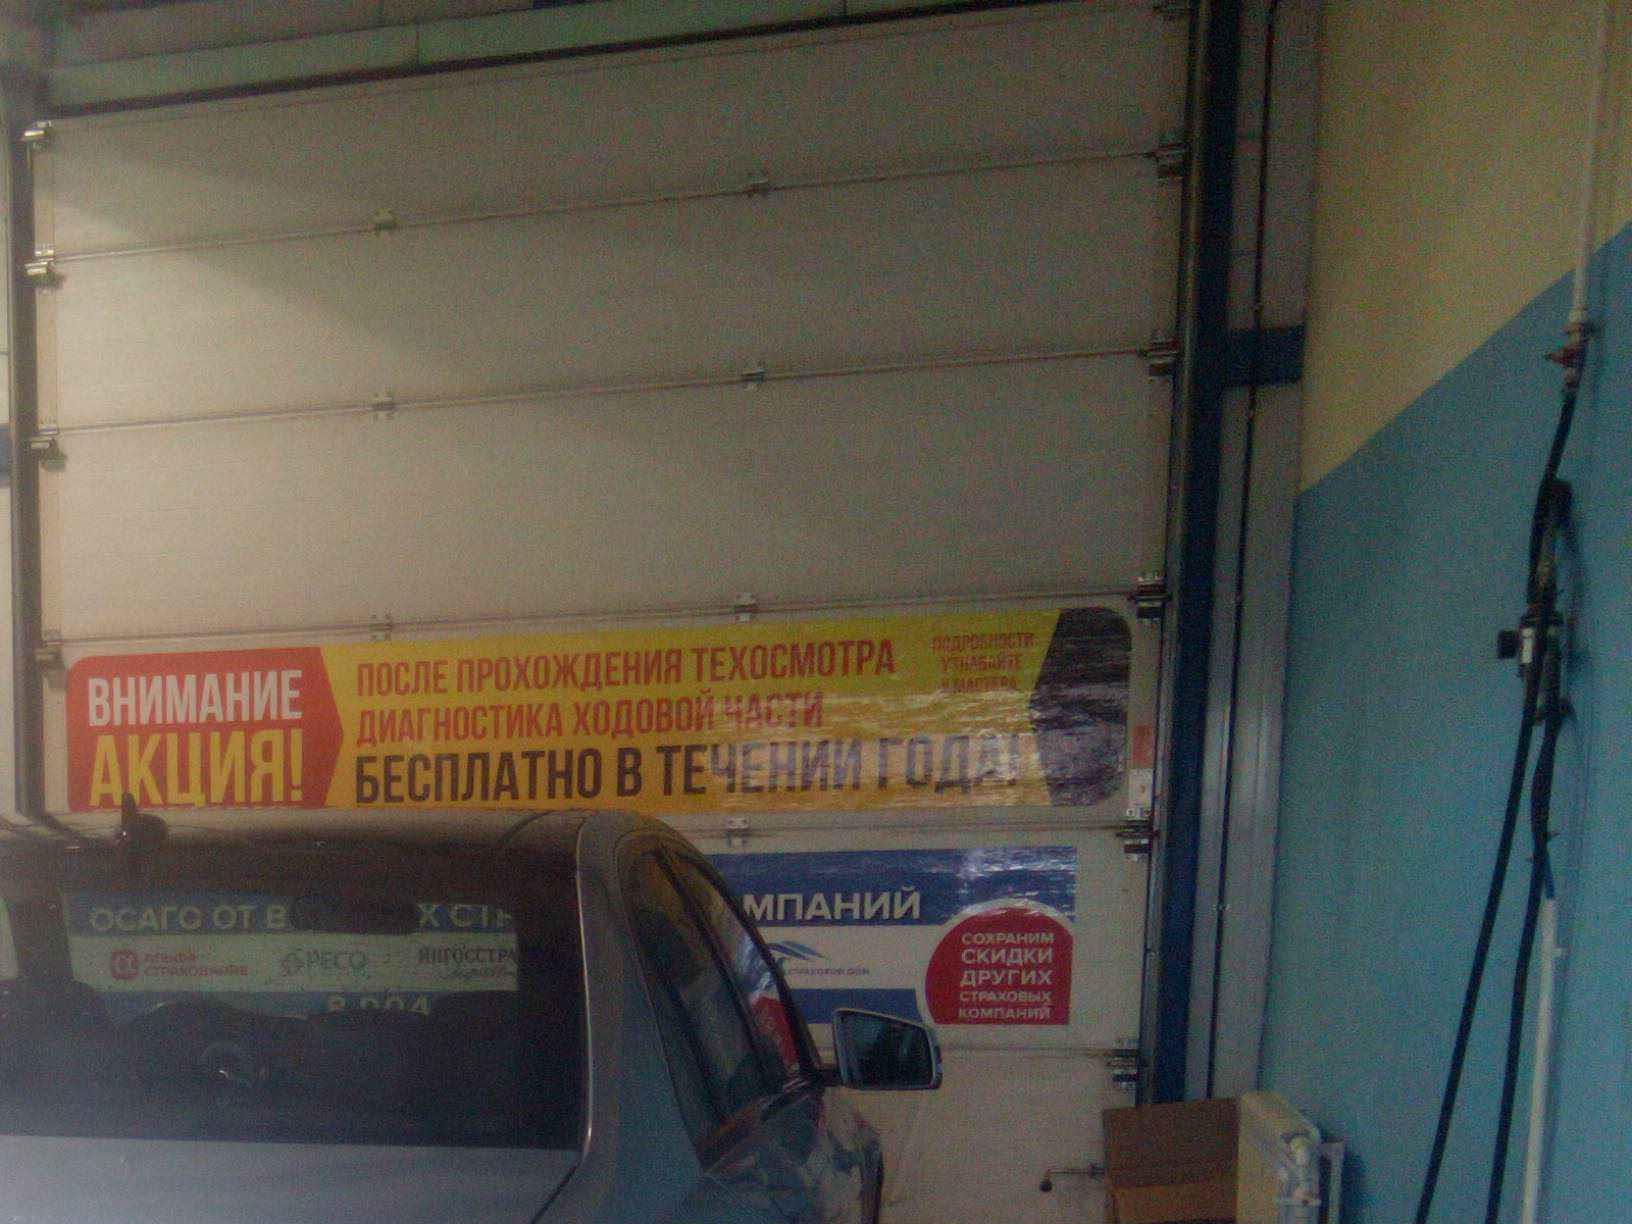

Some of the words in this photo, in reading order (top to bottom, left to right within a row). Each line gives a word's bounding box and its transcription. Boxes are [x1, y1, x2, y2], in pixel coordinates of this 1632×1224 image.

[357, 660, 449, 697] ПОСЛЕ
[456, 650, 682, 692] ПРОХОЖДЕНИЯ
[692, 640, 896, 683] ТЕХОСМОТРА
[88, 669, 303, 727] ВНИМАНИЕ
[356, 702, 565, 748] ДИАГНОСТИКА
[573, 688, 715, 739] ХОДОВОЙ
[722, 691, 824, 729] ЧАСТИ
[88, 728, 304, 808] АКЦИЯ!
[356, 747, 603, 804] БЕСПЛАТНО
[616, 746, 644, 797] В
[656, 738, 863, 797] ТЕЧЕНИИ
[90, 904, 202, 932] ОСАГО
[213, 904, 258, 930] ОТ
[961, 931, 1055, 945] СОХРАНИМ
[961, 948, 1054, 966] СКИДКИ
[959, 969, 1053, 987] ДРУГИХ
[959, 990, 1053, 1002] СТРАХОВЫХ
[957, 1002, 1052, 1019] КОМПАНИЙ
